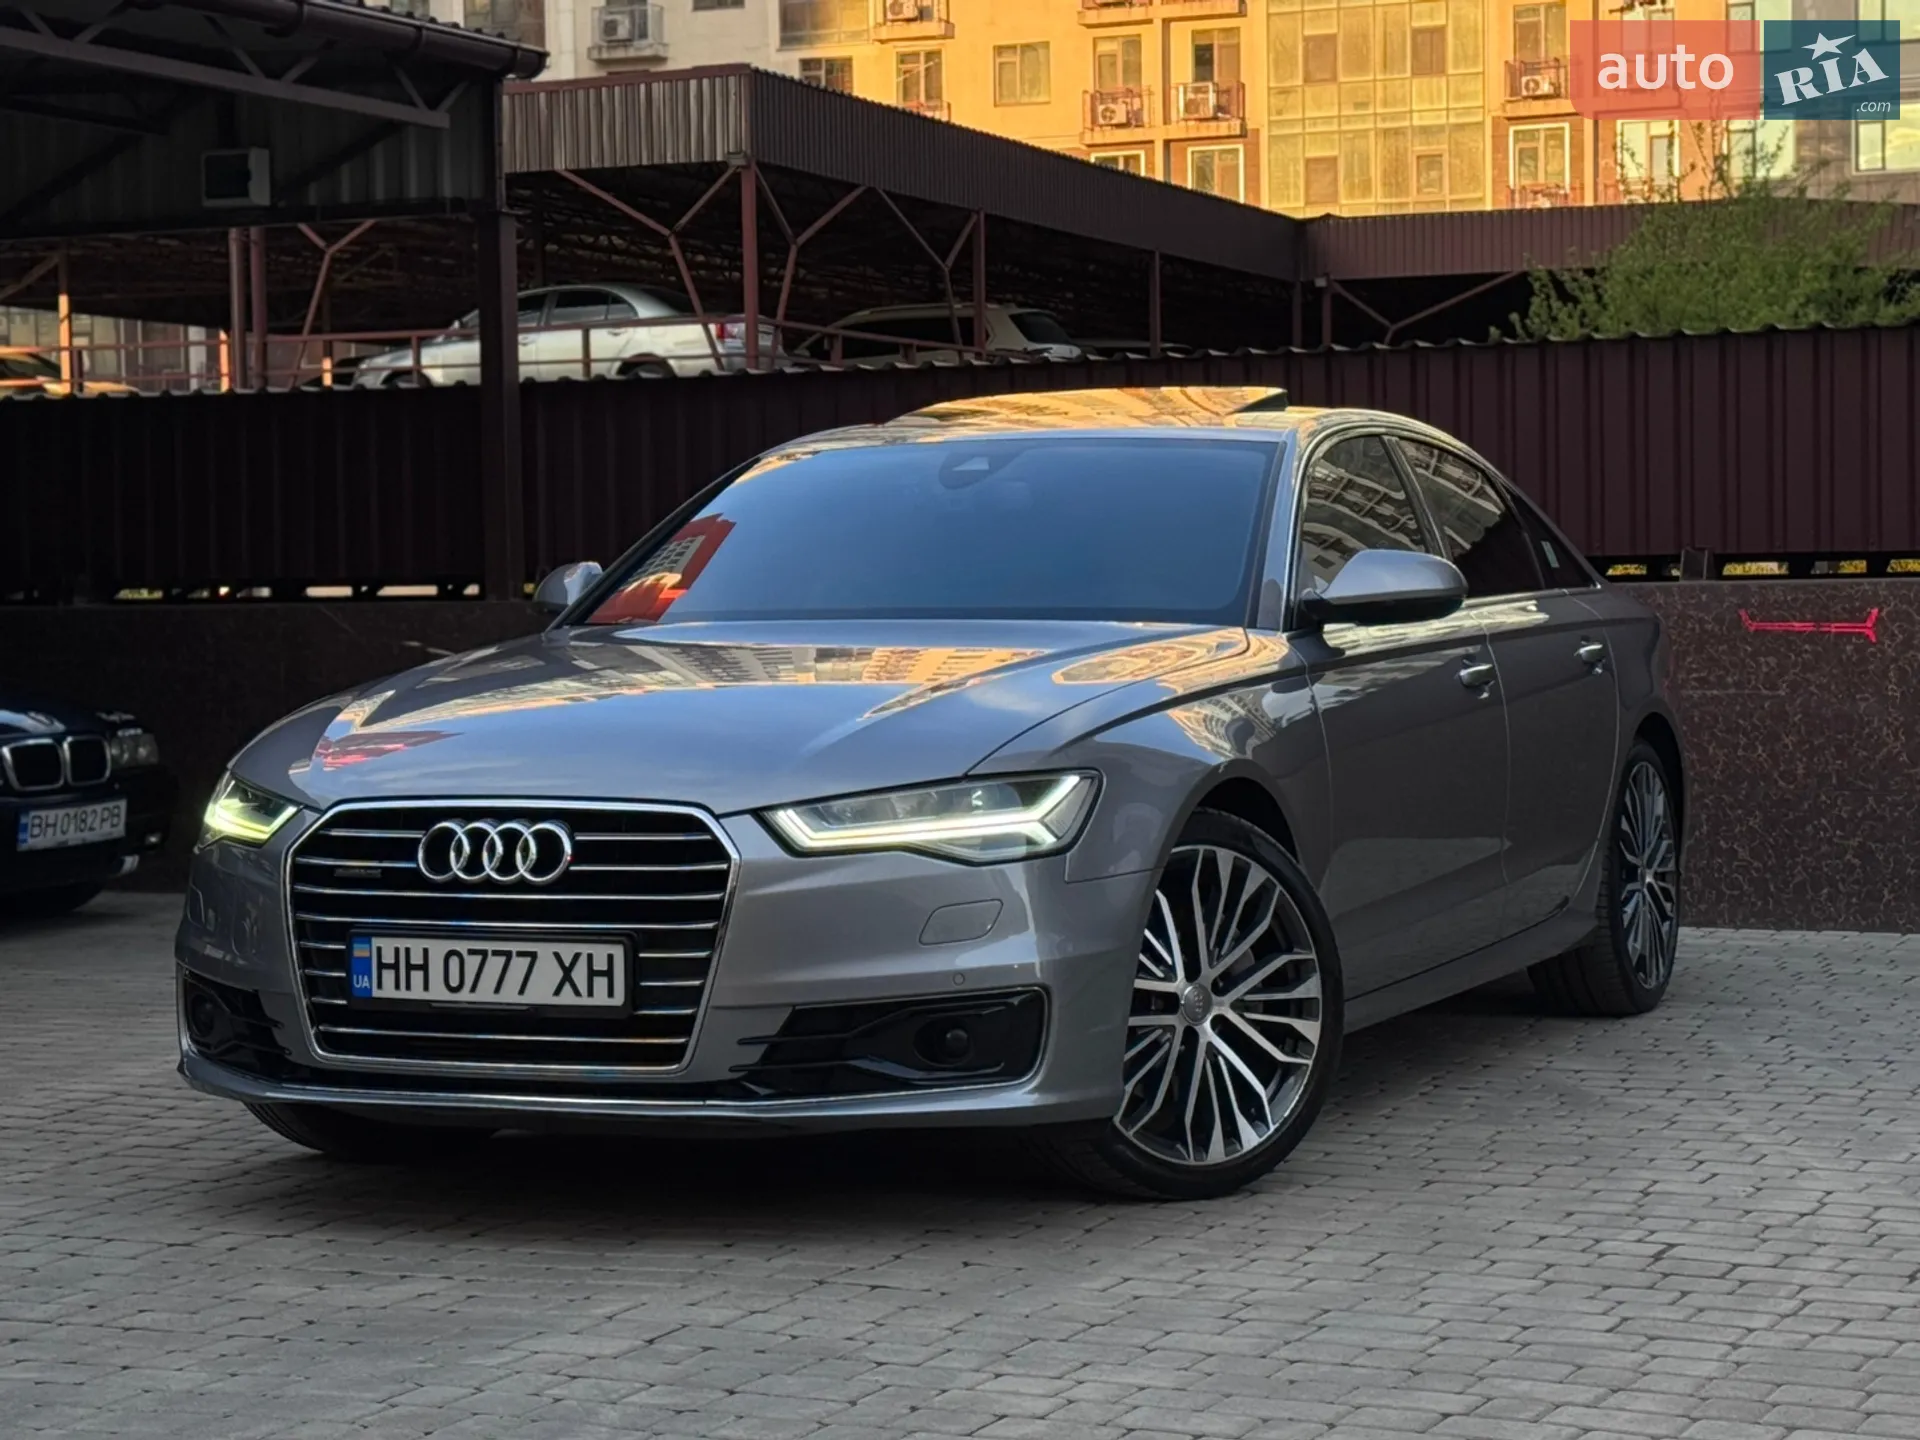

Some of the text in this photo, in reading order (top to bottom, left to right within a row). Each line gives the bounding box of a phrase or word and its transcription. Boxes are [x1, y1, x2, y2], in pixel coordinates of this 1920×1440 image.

[30, 813, 58, 838] BH
[61, 809, 98, 835] 0182
[101, 805, 121, 829] PB
[353, 974, 370, 989] UA
[375, 946, 615, 998] HH 0777 XH
